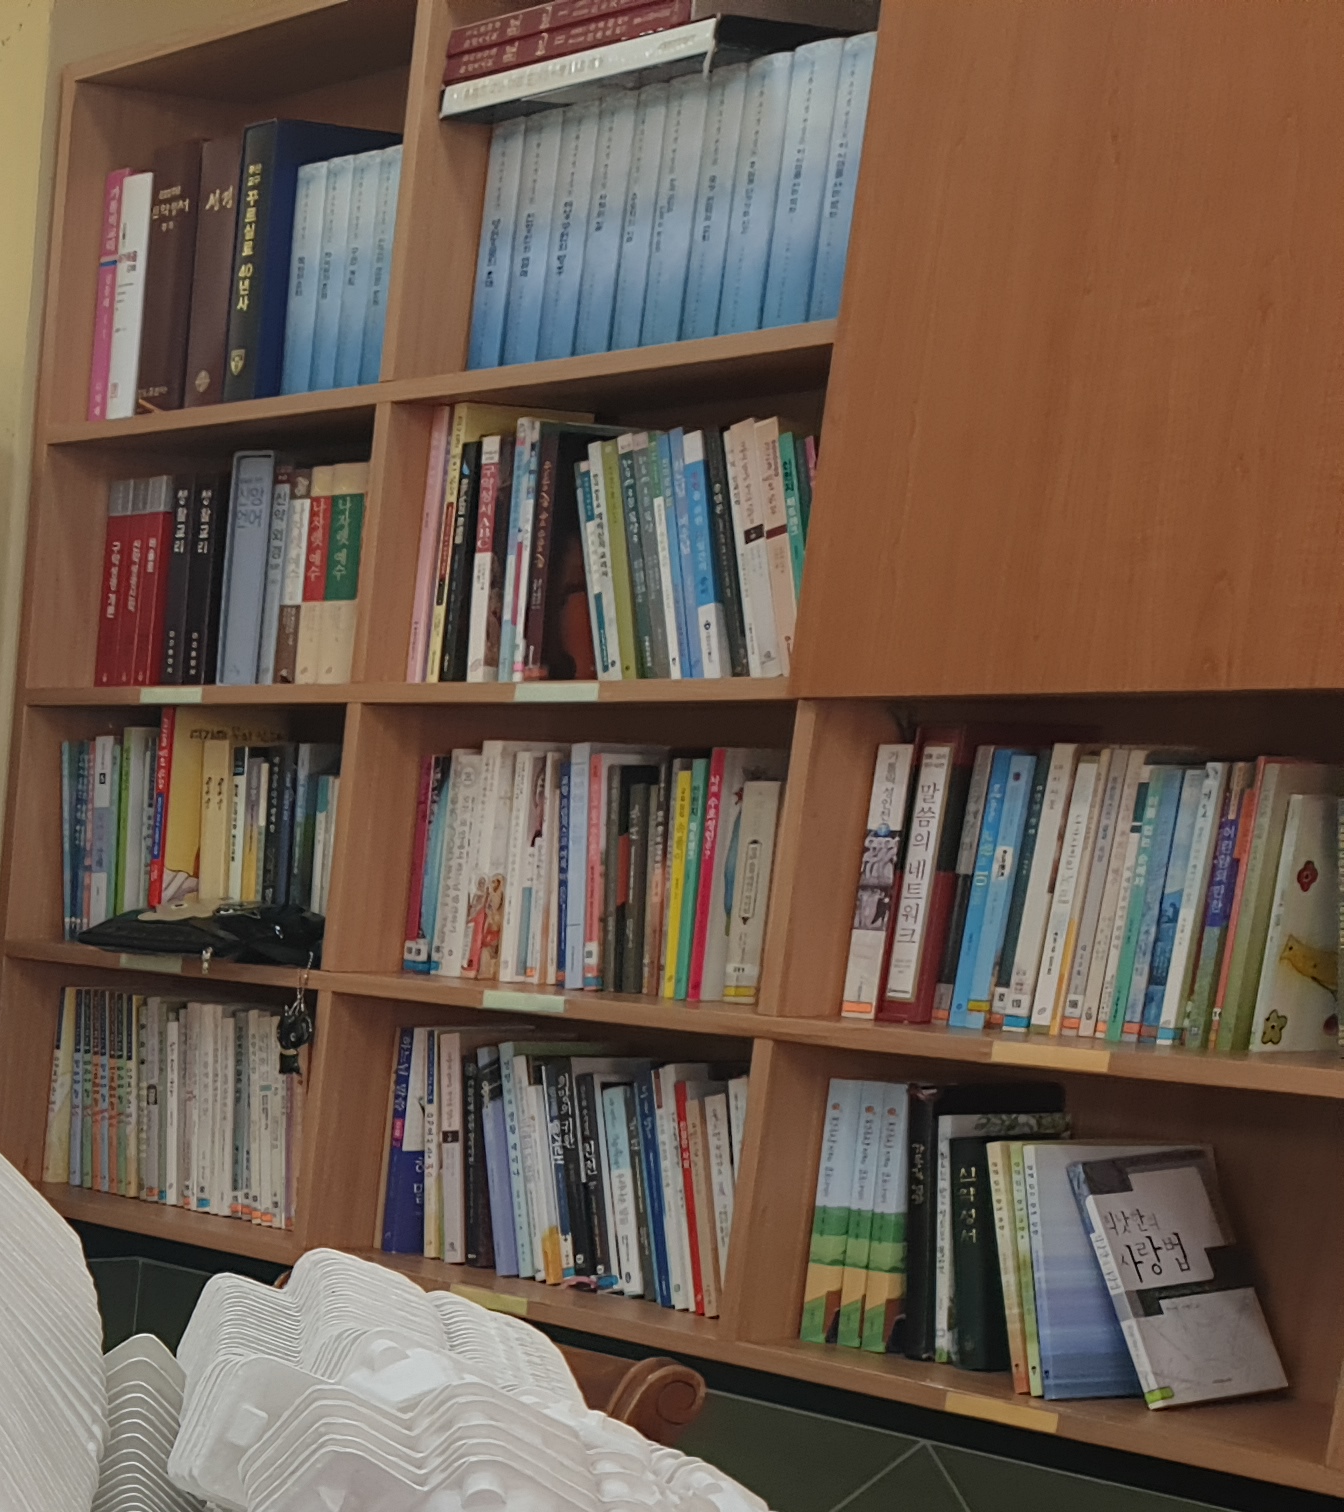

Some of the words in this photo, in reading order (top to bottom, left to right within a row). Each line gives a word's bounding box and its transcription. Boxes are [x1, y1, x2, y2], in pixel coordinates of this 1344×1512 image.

[912, 782, 940, 852] 말씀의
[896, 858, 927, 944] 네트워크
[959, 1166, 977, 1244] 신약성서
[1121, 1232, 1191, 1284] 사랑법
